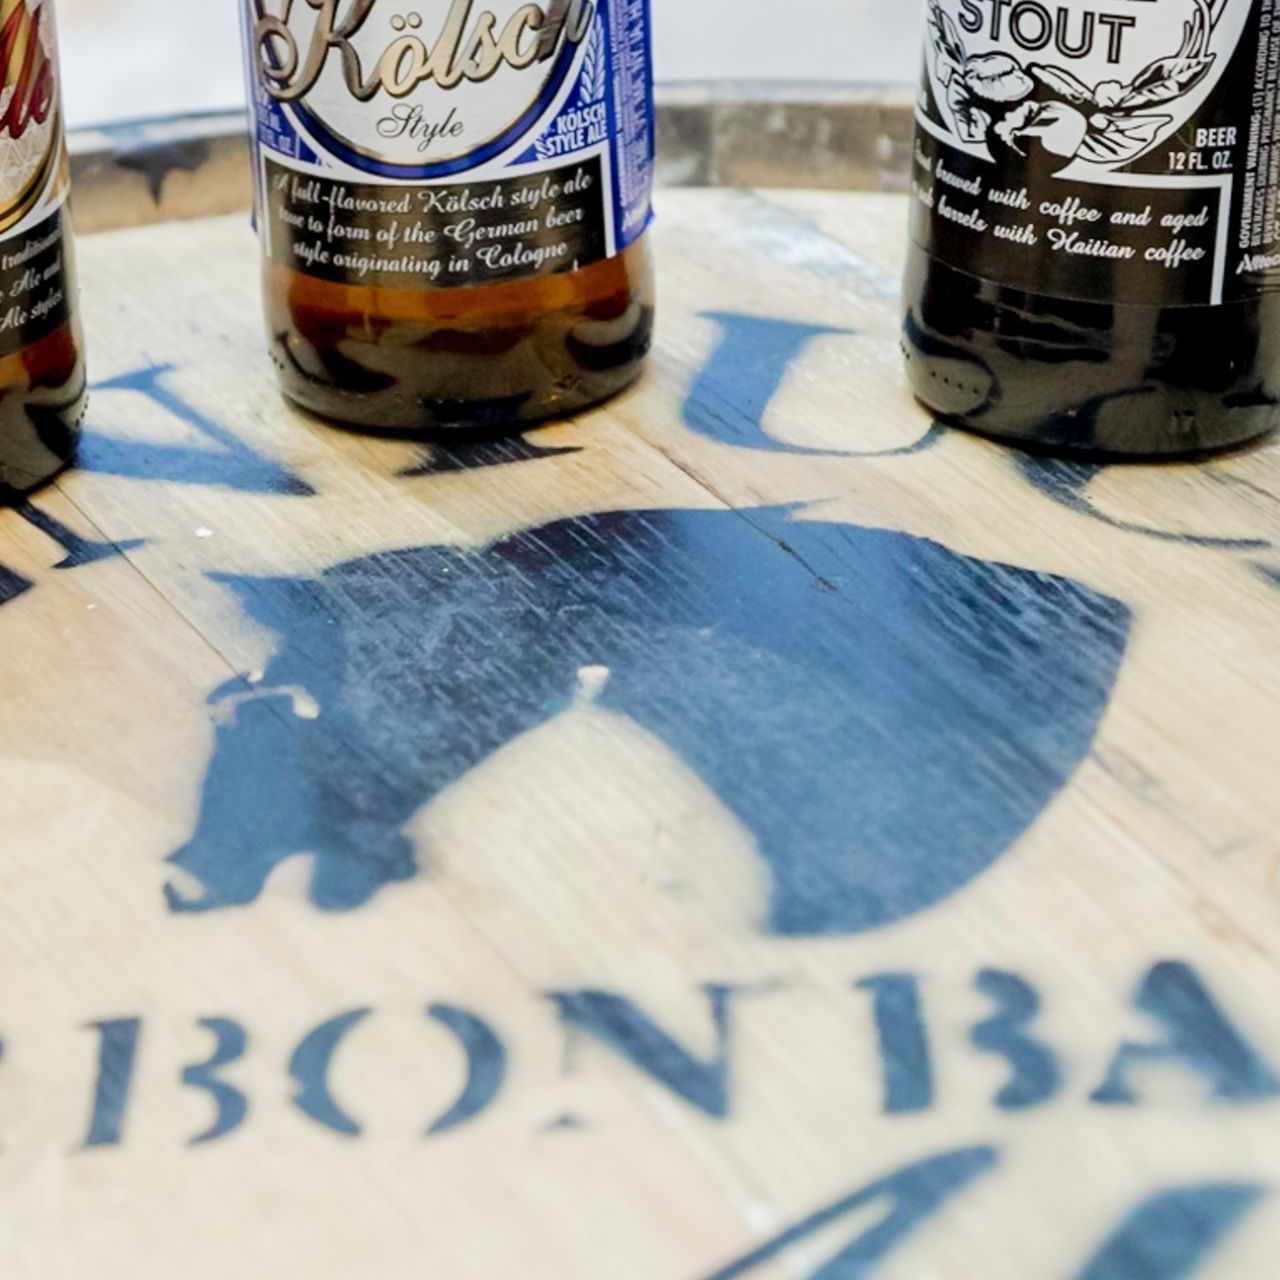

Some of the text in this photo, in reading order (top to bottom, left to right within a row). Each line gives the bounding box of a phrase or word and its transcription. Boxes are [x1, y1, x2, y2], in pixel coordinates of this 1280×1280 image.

[1260, 14, 1271, 27] TO
[1253, 30, 1270, 89] ACCORDING
[375, 103, 464, 155] Style
[545, 122, 608, 155] STYLE ALE
[556, 100, 606, 136] KÖLSCH
[1195, 126, 1237, 148] BEER
[1246, 110, 1261, 169] WARNING:
[1168, 151, 1233, 170] 12 FL. OZ.
[291, 178, 411, 217] full-flavored
[418, 185, 504, 213] Kölsch
[510, 177, 560, 209] style
[563, 168, 593, 196] ale
[935, 159, 982, 196] brewed
[988, 187, 1031, 211] with
[1039, 197, 1101, 227] coffee
[1110, 206, 1151, 227] and
[1160, 206, 1209, 234] aged
[1239, 172, 1256, 248] GOVERNMENT
[308, 213, 323, 233] to
[327, 214, 370, 244] form
[376, 219, 398, 250] of
[404, 220, 435, 243] the
[443, 218, 539, 249] German
[546, 206, 584, 230] beer
[994, 224, 1038, 247] with
[1047, 227, 1135, 260] Haitian
[1144, 240, 1206, 268] coffee
[293, 239, 568, 280] style originating in Cologne
[9, 271, 41, 297] Ale
